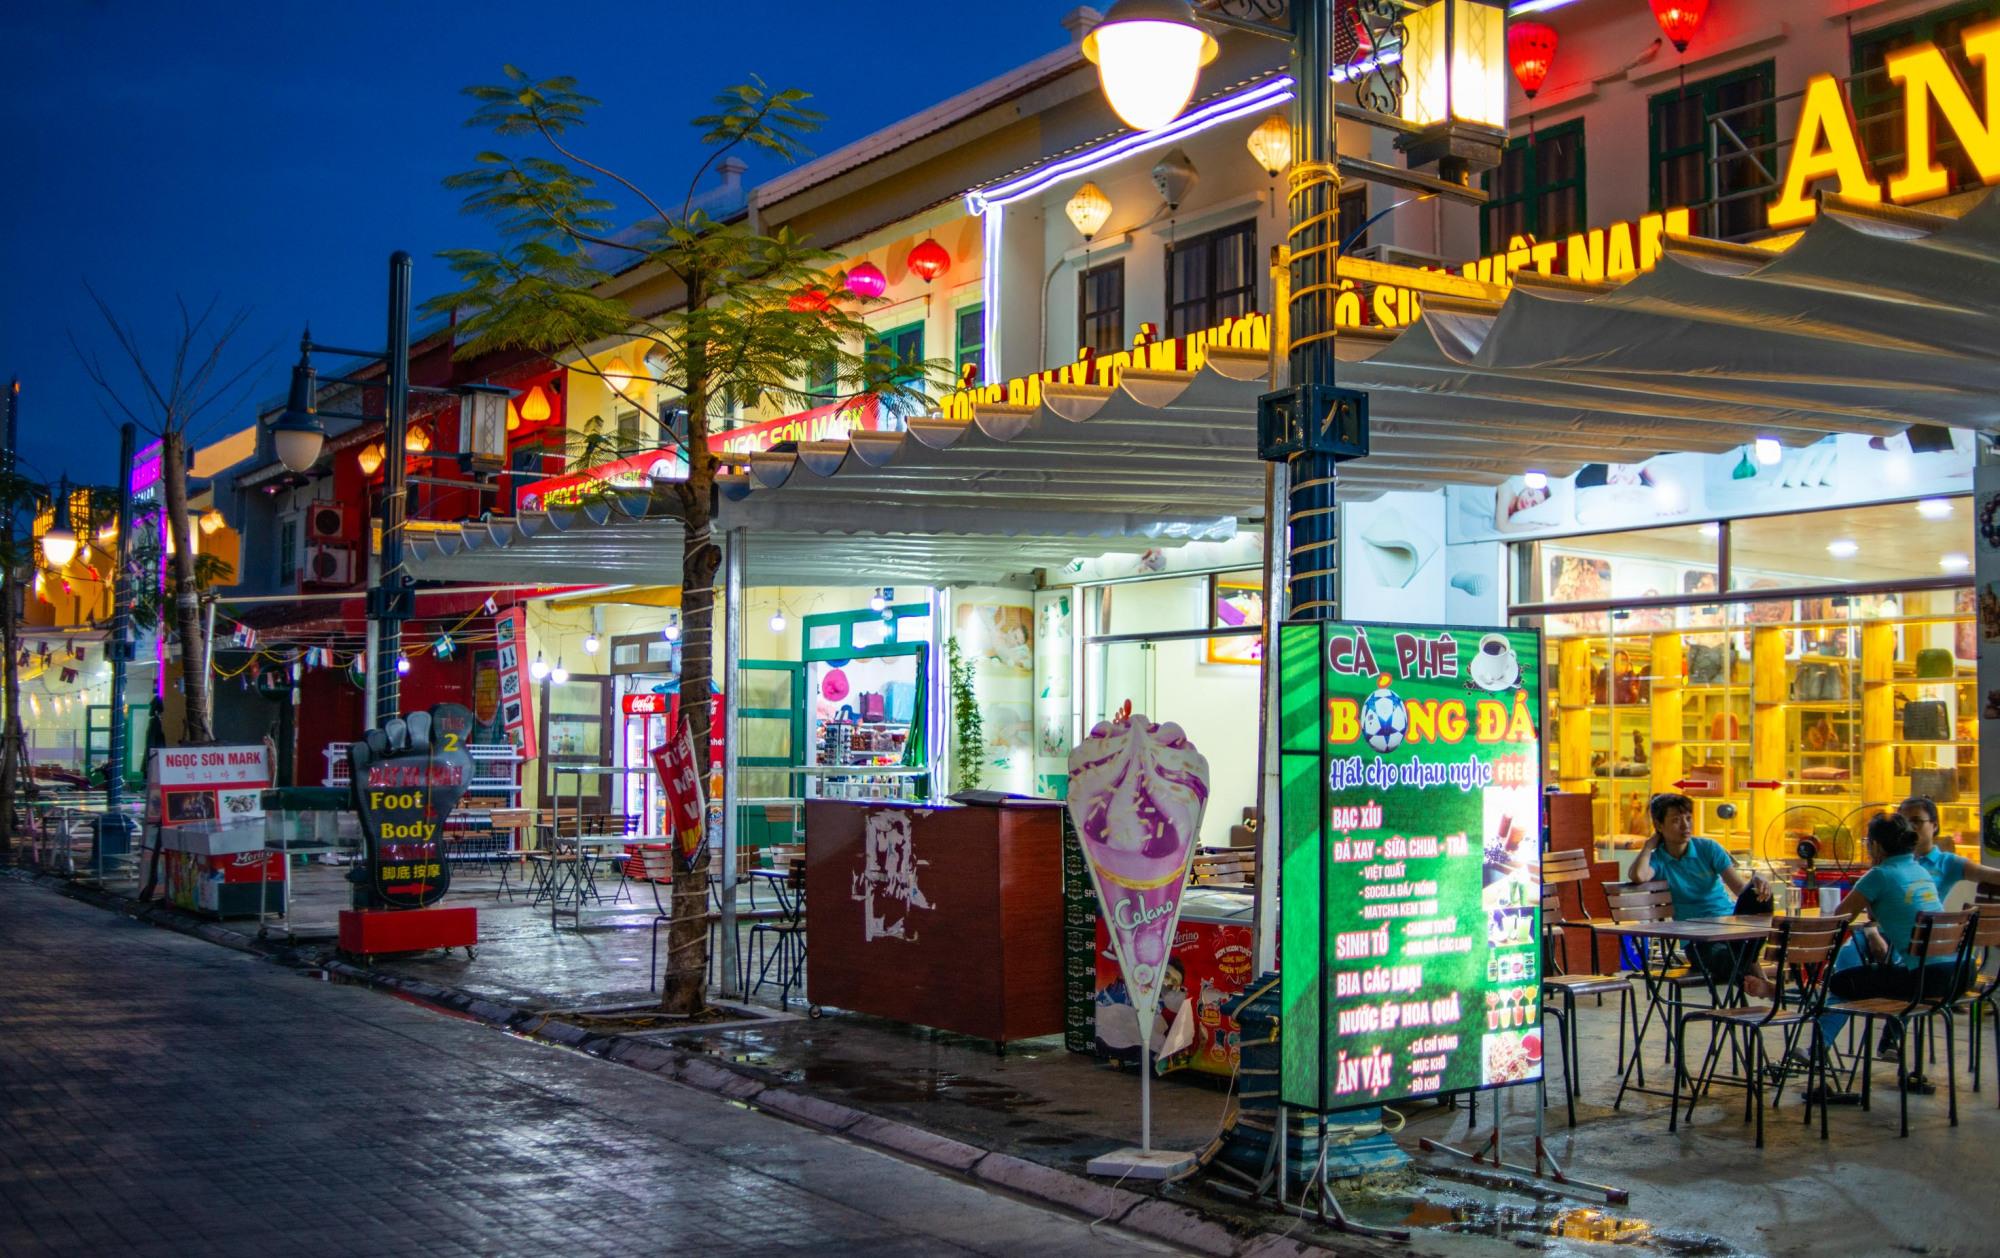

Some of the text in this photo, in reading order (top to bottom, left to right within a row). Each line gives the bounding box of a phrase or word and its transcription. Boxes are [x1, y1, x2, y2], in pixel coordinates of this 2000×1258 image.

[1567, 208, 1690, 282] NAM
[1329, 626, 1459, 679] CÀ PHÊ
[1476, 689, 1538, 743] ĐÁ
[443, 733, 460, 752] 2
[165, 751, 261, 769] NGỌC SƠN MARK
[1366, 755, 1398, 790] cho
[1400, 754, 1447, 789] nhau
[370, 790, 424, 811] Foot
[380, 820, 437, 841] Body
[1332, 806, 1359, 834] BẠC
[1334, 837, 1351, 862] ĐÁ
[1353, 839, 1376, 862] XAY
[1408, 836, 1439, 858] CHUA
[1364, 884, 1396, 900] SOCOLA
[1114, 894, 1174, 930] Celano
[1364, 904, 1399, 920] MATCHA
[1336, 921, 1391, 960] SINH TỐ
[1336, 971, 1361, 999] BIA
[1363, 964, 1391, 994] CÁC
[1380, 1000, 1401, 1030] ÉP
[1402, 1001, 1430, 1027] HOA
